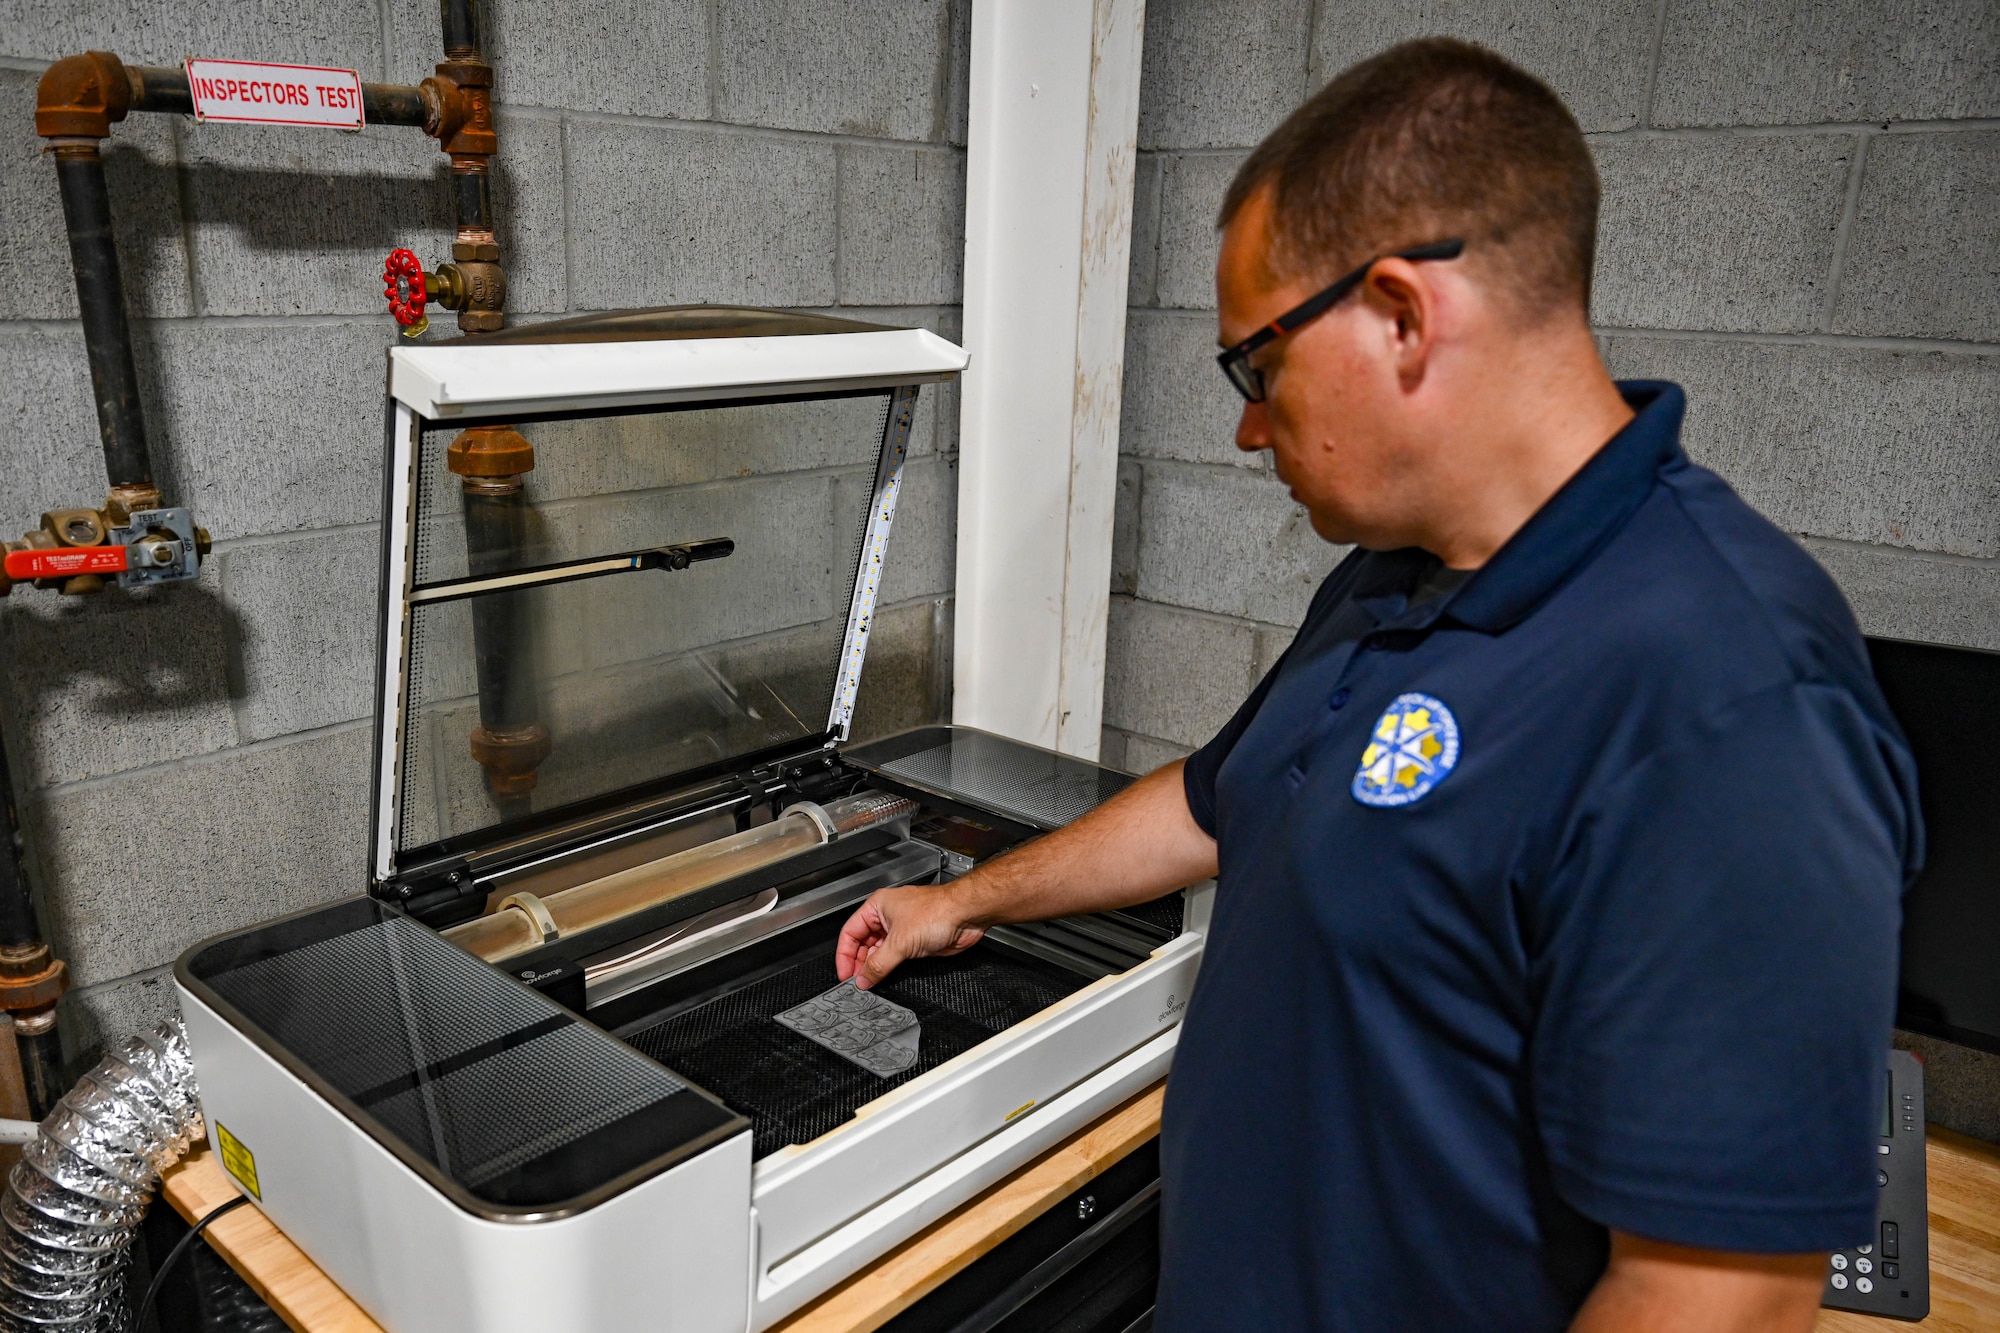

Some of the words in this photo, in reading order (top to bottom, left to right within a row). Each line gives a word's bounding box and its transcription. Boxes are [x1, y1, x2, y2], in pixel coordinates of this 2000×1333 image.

[195, 77, 309, 106] INSPECTORS
[316, 86, 356, 109] TEST
[138, 514, 157, 522] TEST
[184, 537, 193, 552] OFF
